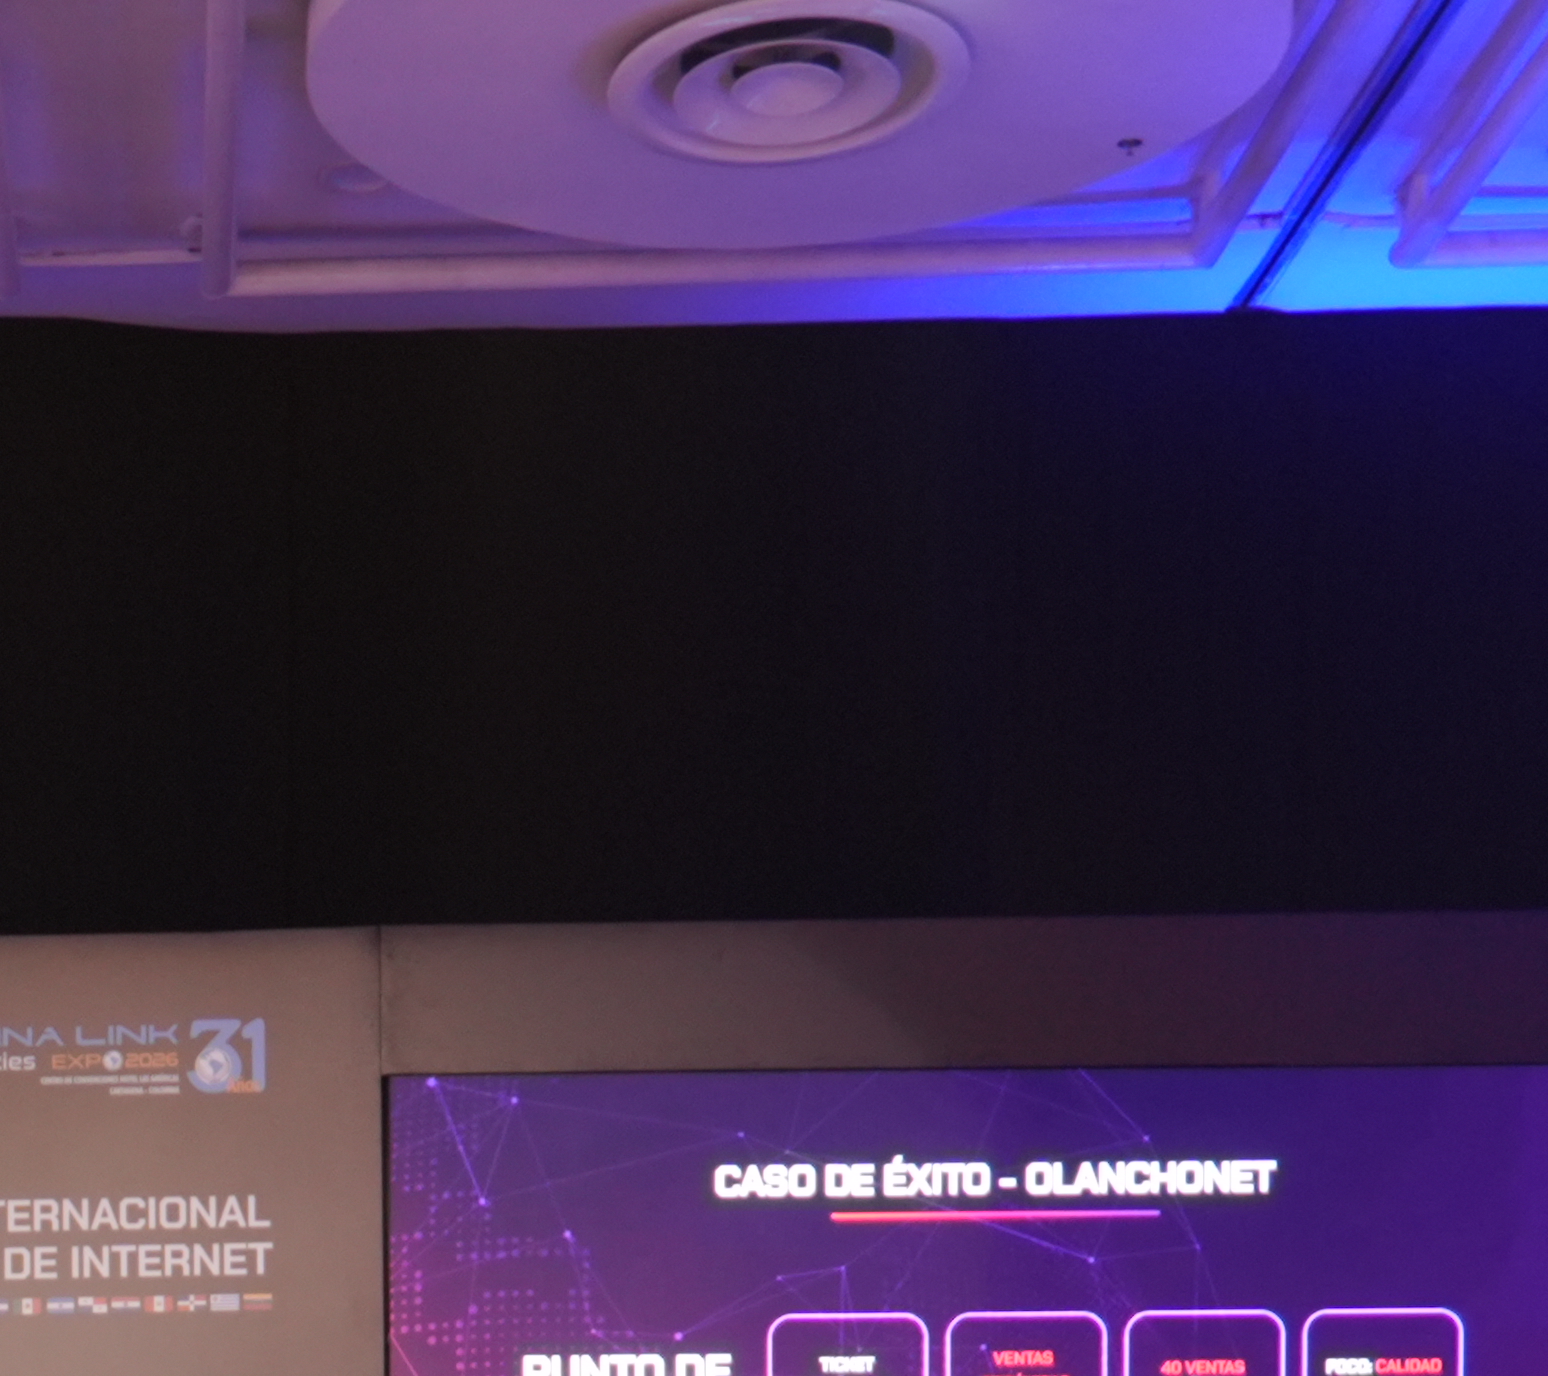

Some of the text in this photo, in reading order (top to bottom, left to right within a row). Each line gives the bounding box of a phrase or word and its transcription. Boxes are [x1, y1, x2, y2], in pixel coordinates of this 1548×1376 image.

[75, 1023, 180, 1046] LINK
[125, 1052, 179, 1068] 2026
[188, 1017, 267, 1094] 31
[714, 1155, 1277, 1199] CASO DE ÉXITO OLANCHONET
[4, 1245, 58, 1281] DE
[71, 1242, 273, 1278] INTERNET
[993, 1350, 1055, 1366] VENTAS
[1160, 1359, 1246, 1375] 40 VENTAS
[1375, 1357, 1443, 1374] CALIDAD
